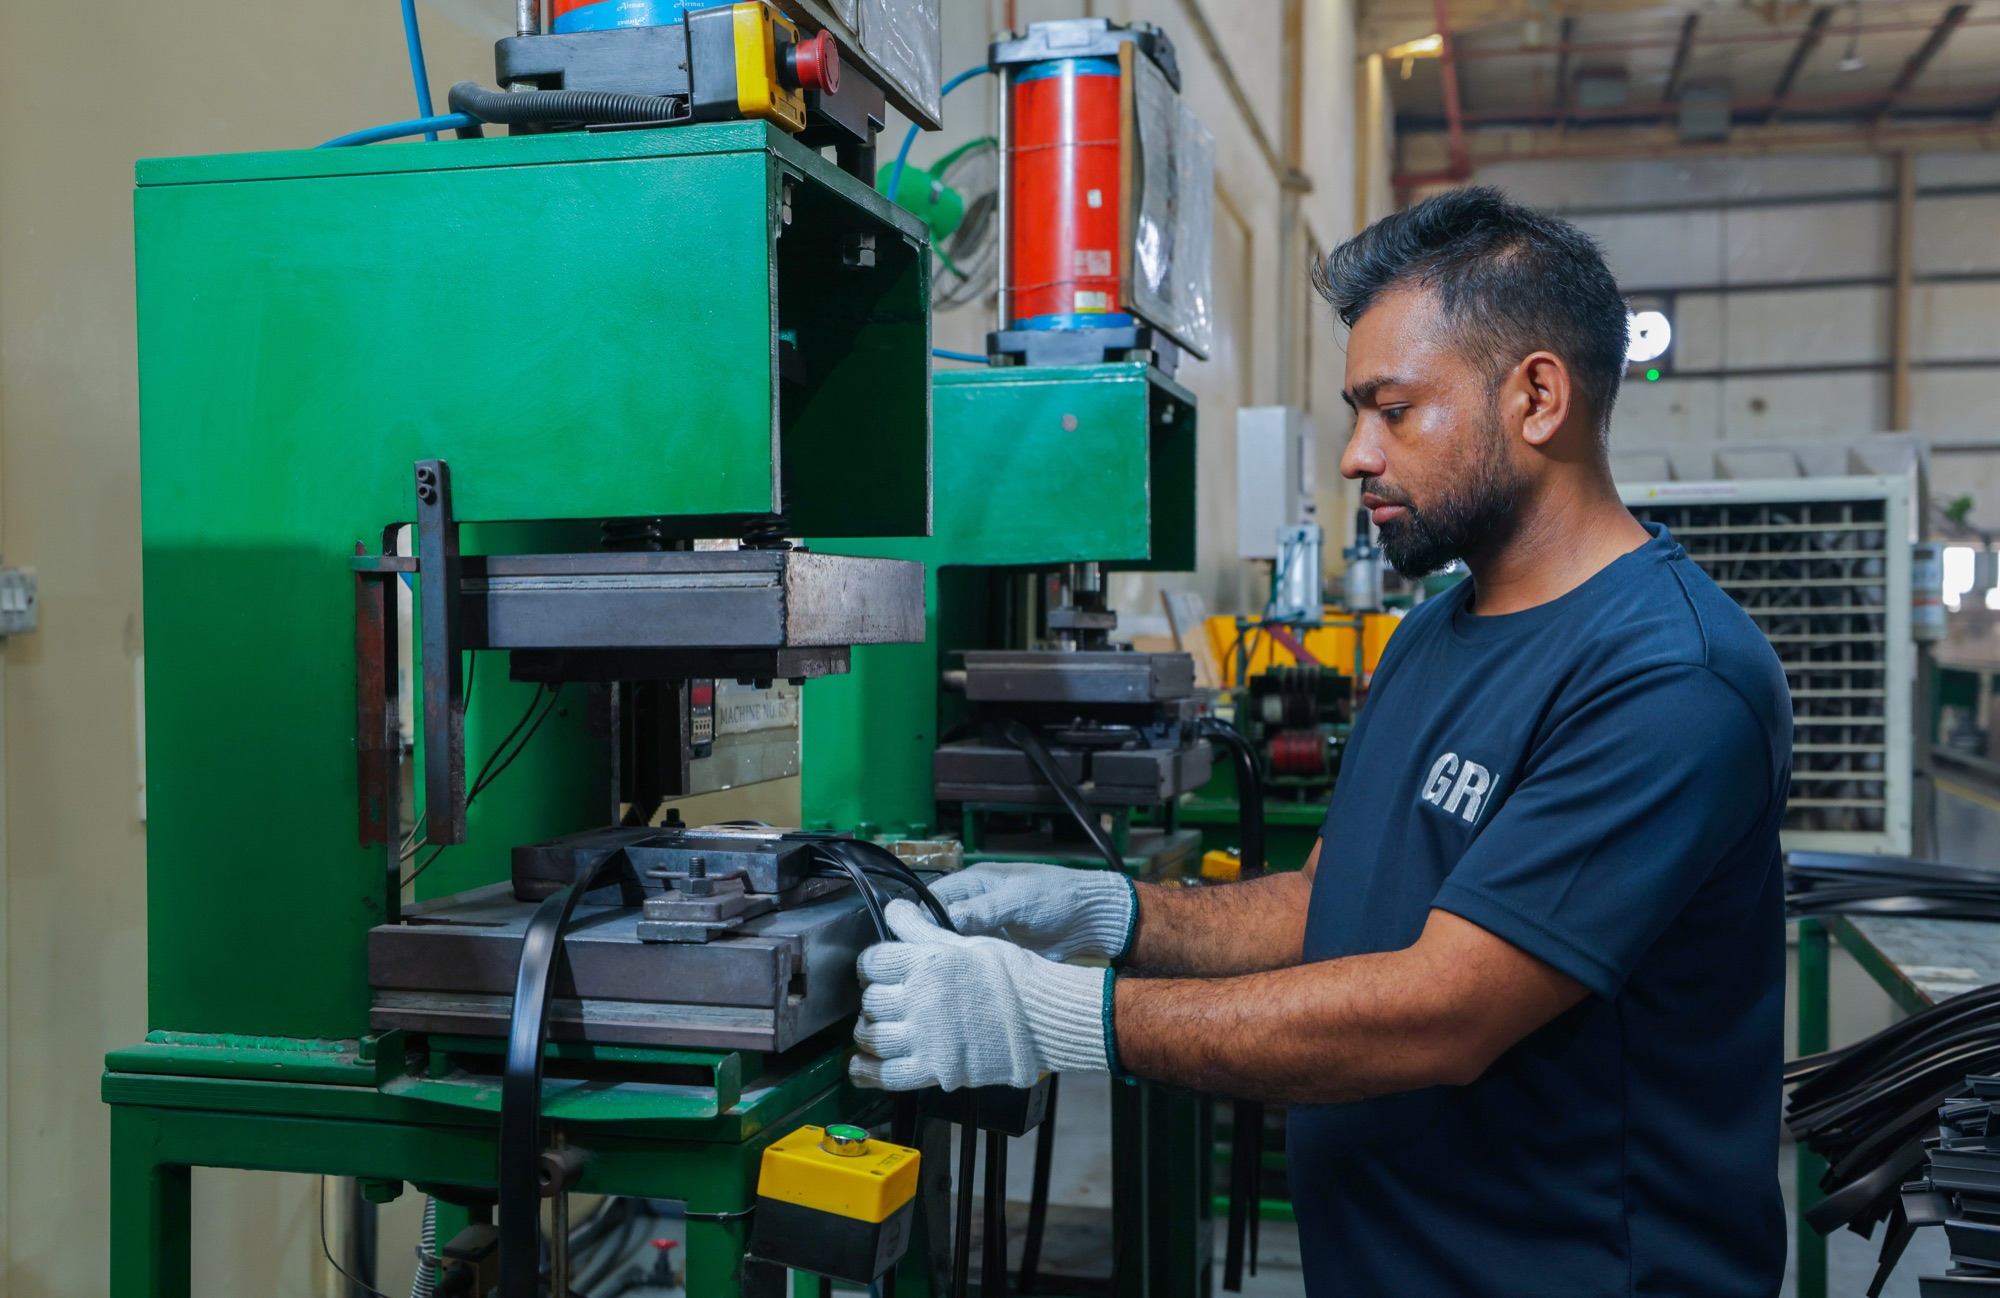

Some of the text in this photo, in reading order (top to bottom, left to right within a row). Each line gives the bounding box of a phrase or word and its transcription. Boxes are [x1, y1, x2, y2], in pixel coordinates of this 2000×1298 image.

[617, 2, 645, 12] Airmax
[673, 0, 705, 8] Airmax
[720, 704, 761, 725] MACHINE
[1422, 752, 1500, 826] GR
